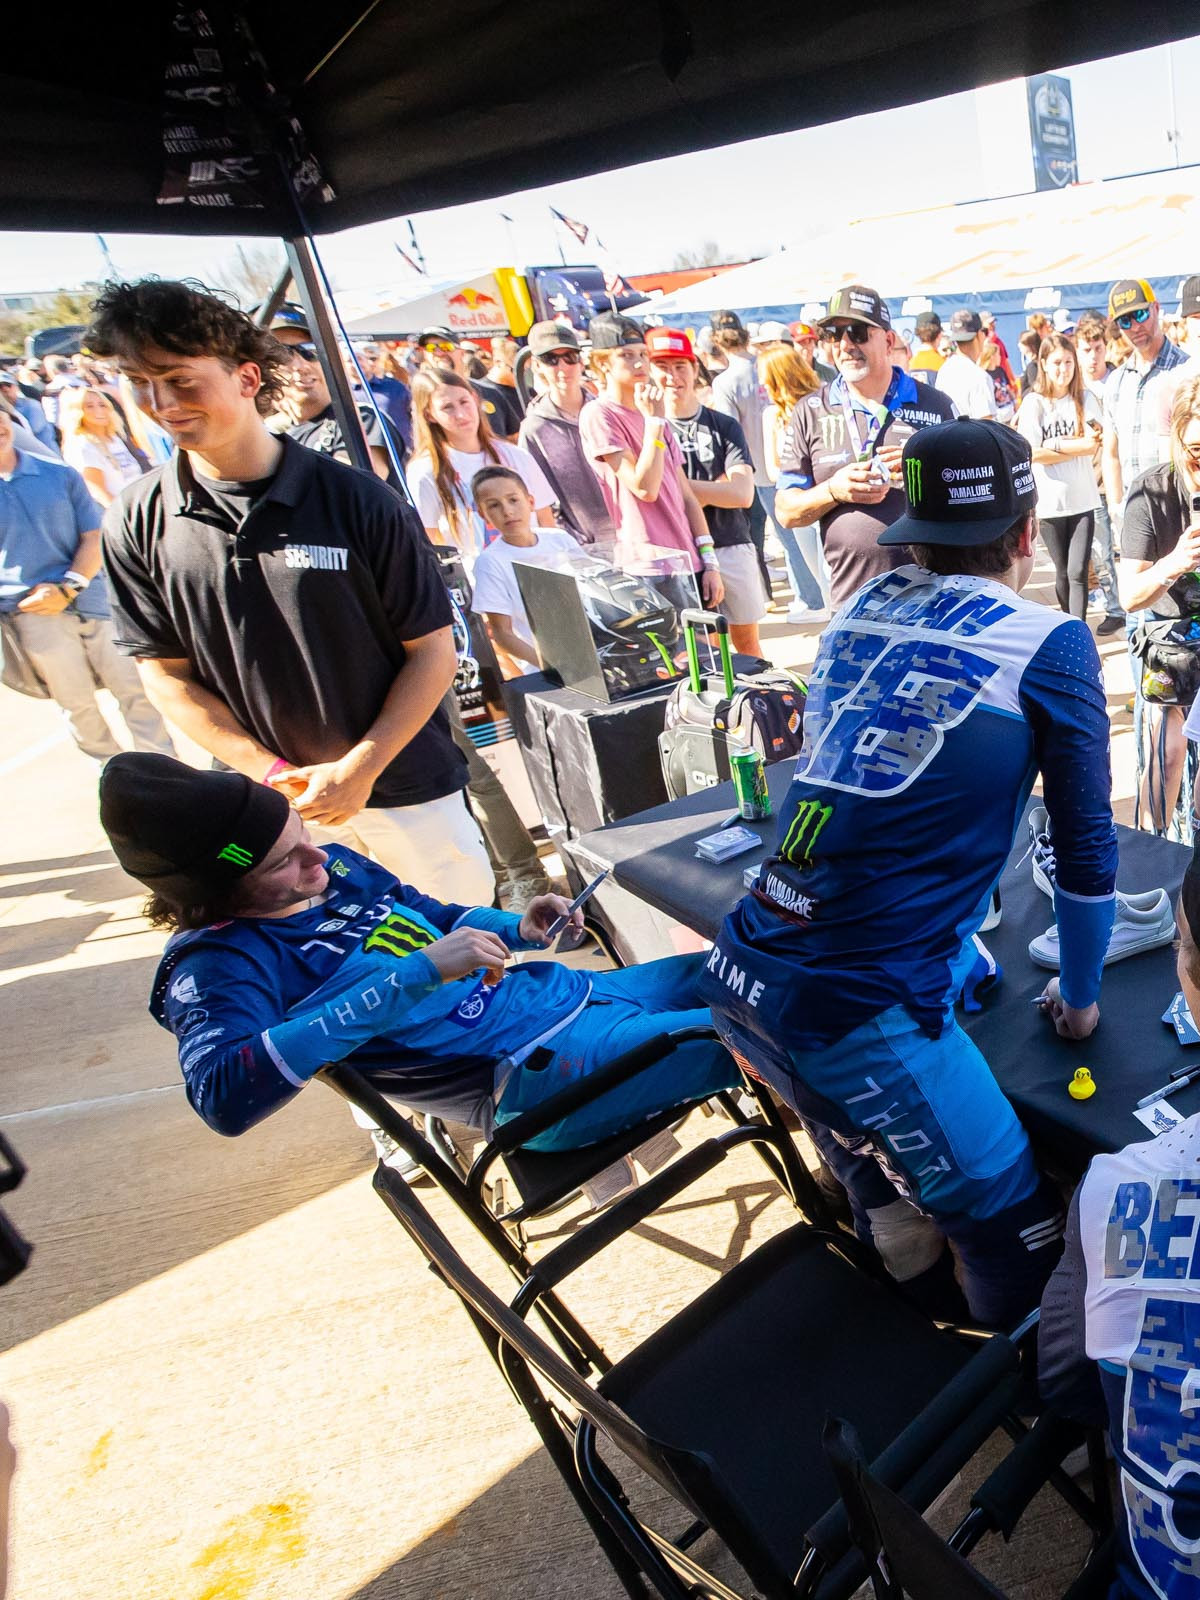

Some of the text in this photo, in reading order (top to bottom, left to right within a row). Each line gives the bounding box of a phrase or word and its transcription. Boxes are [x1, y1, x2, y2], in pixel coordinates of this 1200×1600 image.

[188, 193, 235, 207] SHADE
[449, 312, 505, 327] Red Bull
[903, 407, 942, 425] YAMAHA
[953, 465, 995, 481] YAMAHA
[948, 483, 993, 499] YAMALUBE
[284, 543, 348, 571] SECURITY
